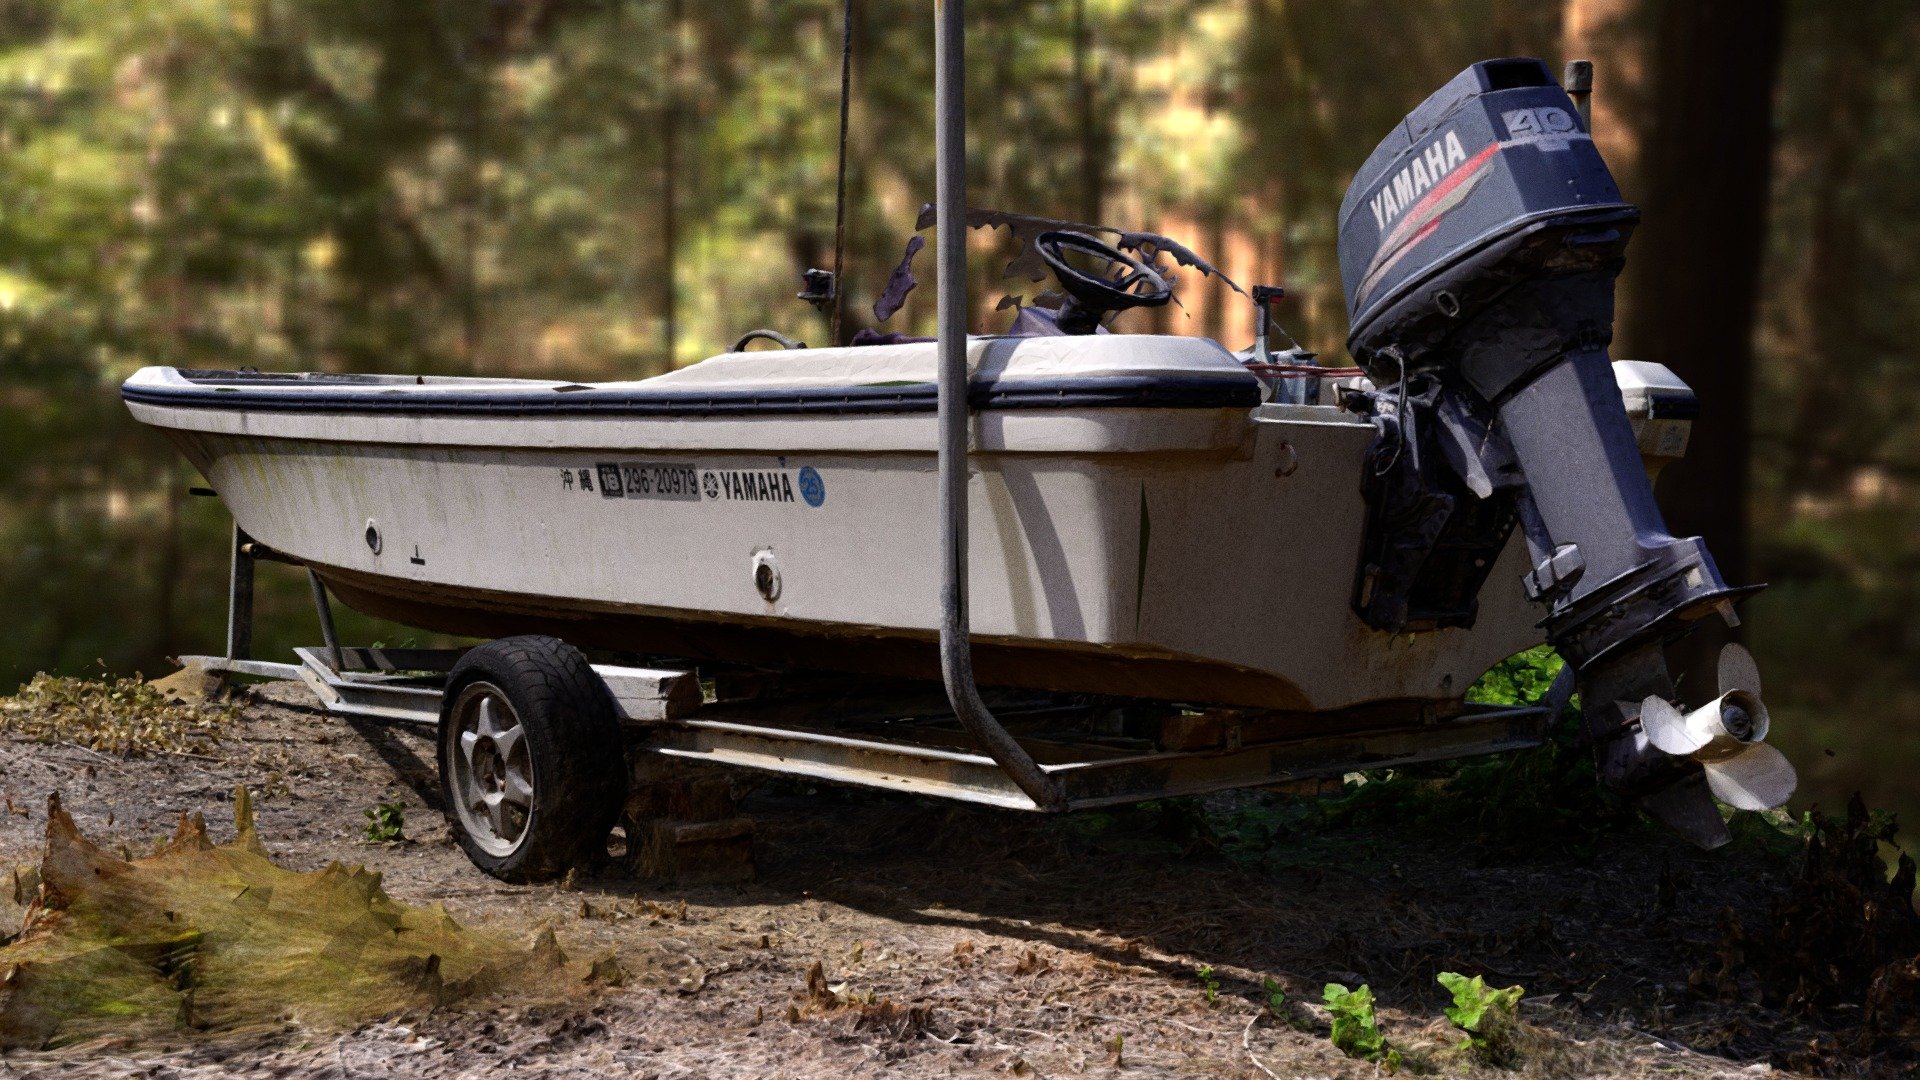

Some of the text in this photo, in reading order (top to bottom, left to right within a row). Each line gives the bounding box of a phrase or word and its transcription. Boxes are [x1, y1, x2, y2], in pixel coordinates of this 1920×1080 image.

[1501, 107, 1574, 139] 40
[1370, 130, 1466, 231] YAMAHA
[624, 468, 698, 495] 296-20979
[720, 471, 795, 502] YAMAHA
